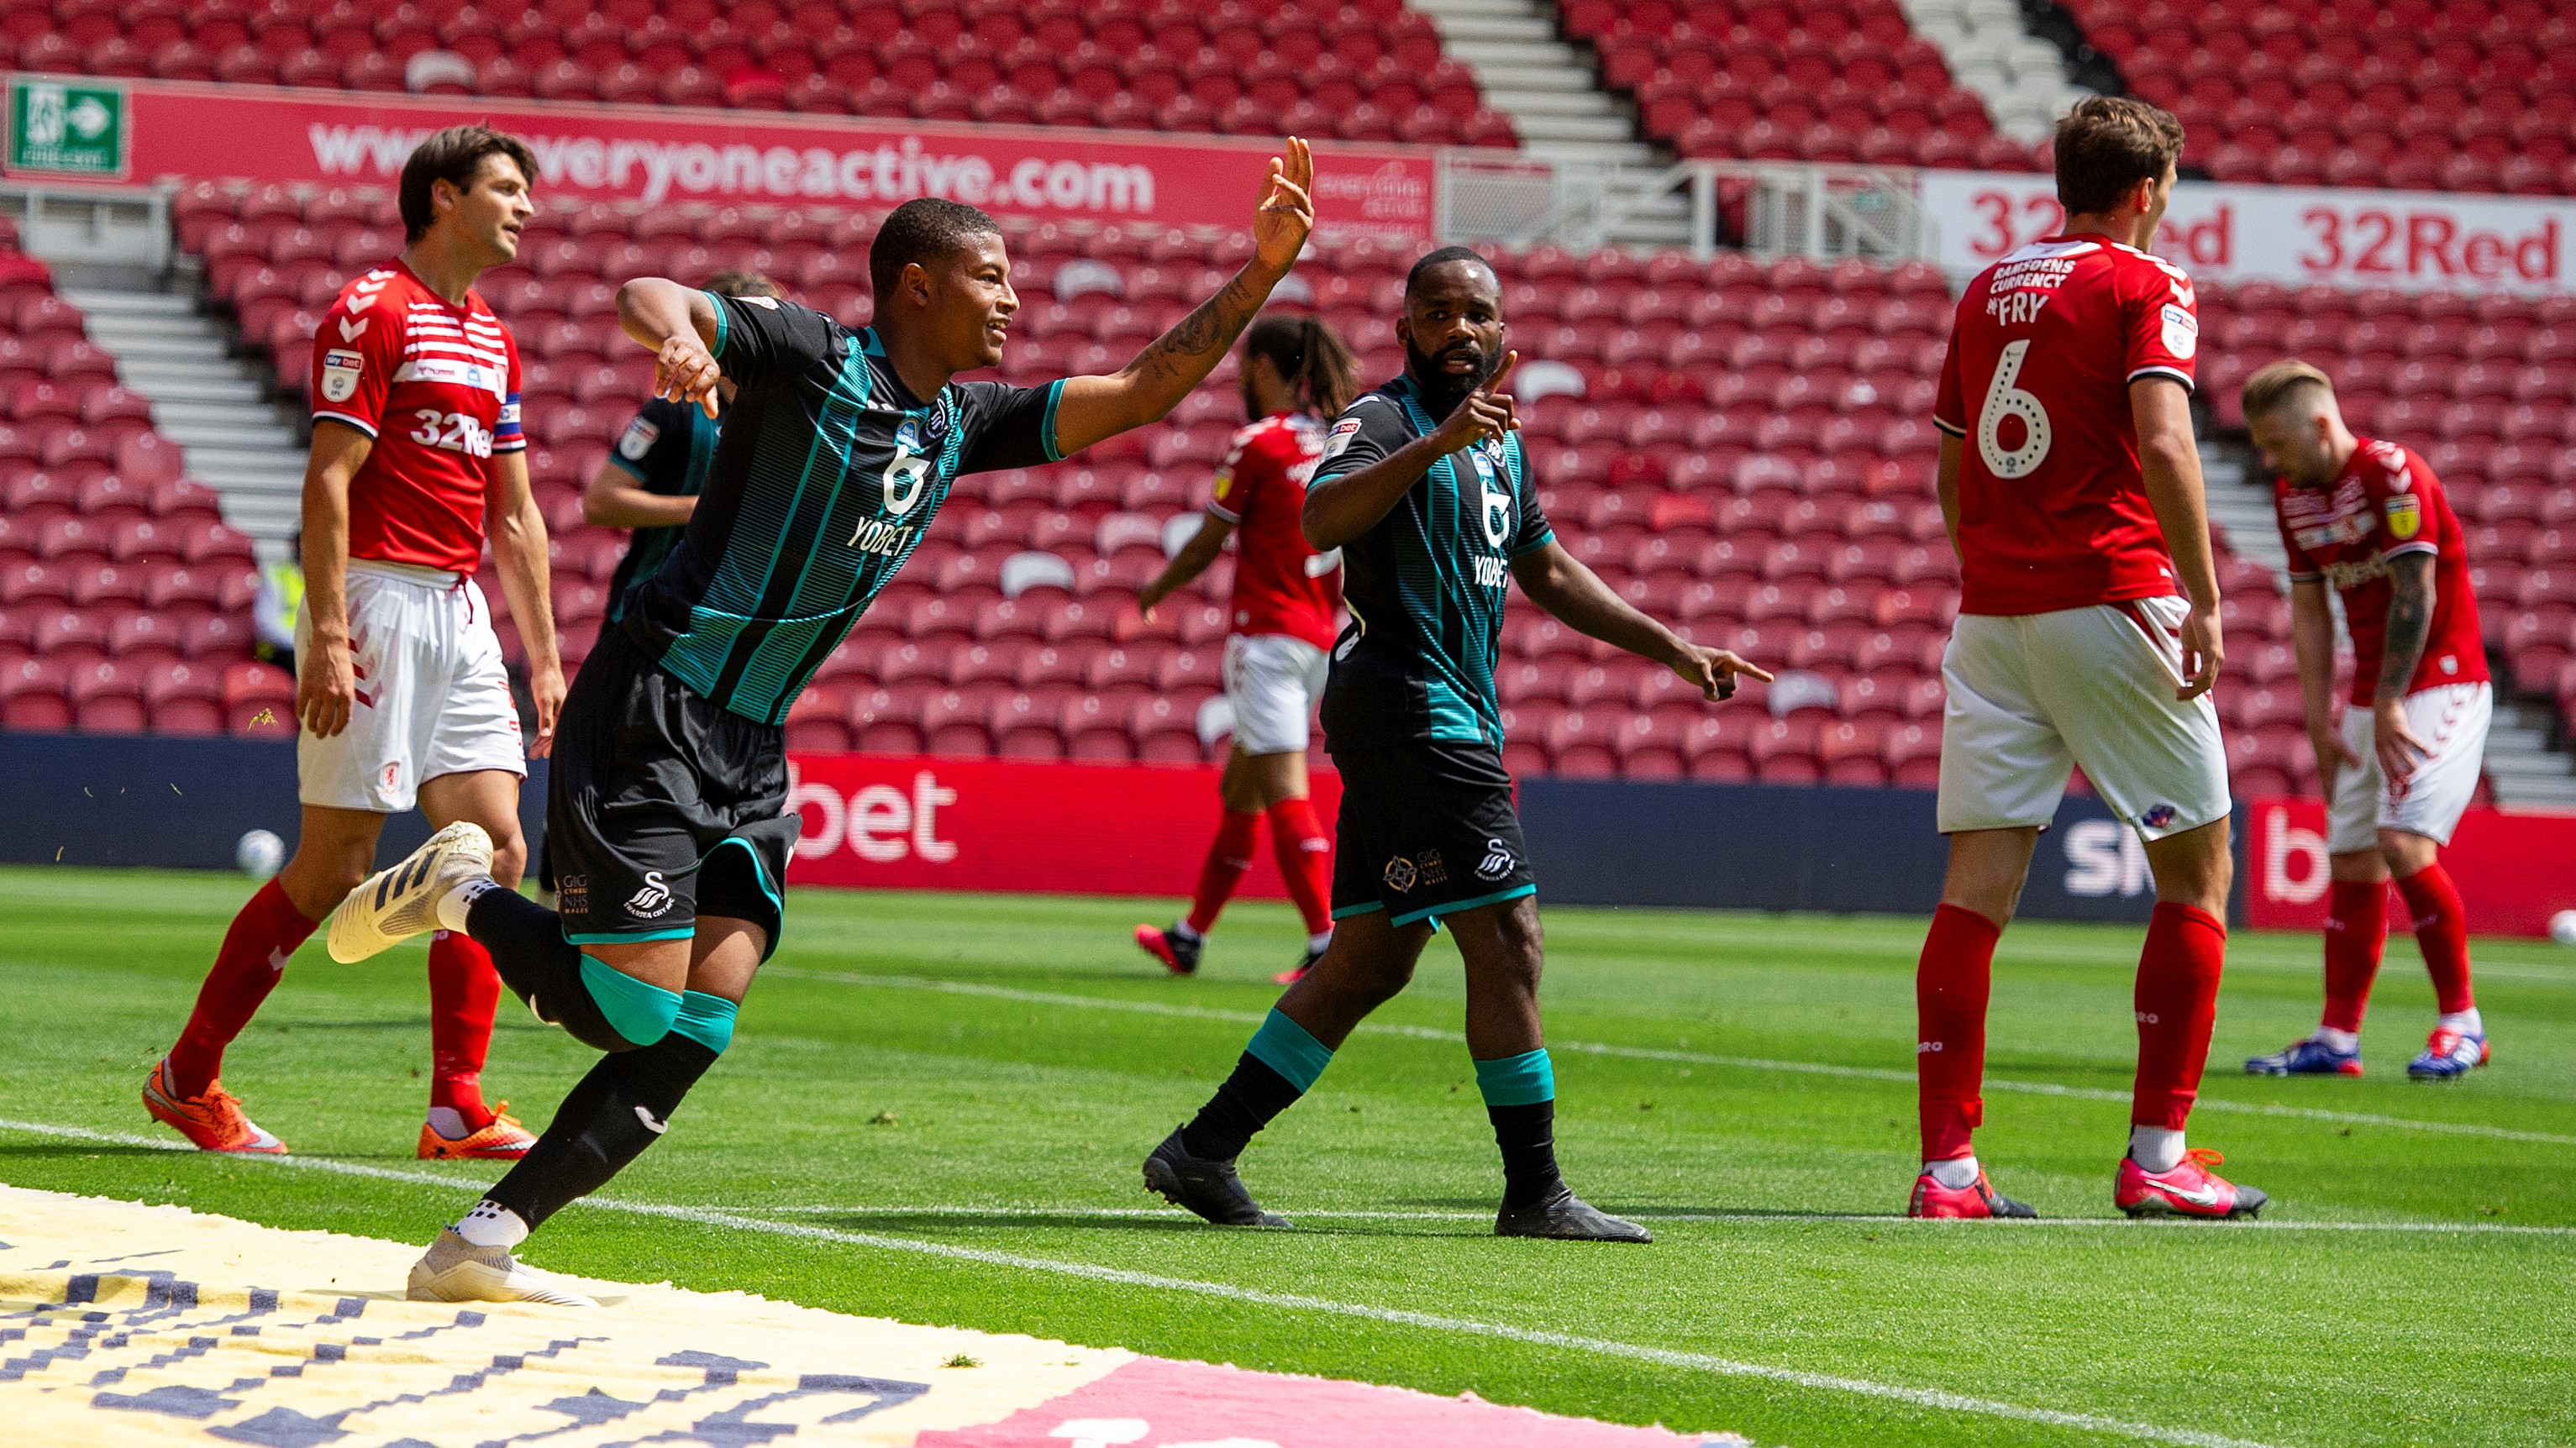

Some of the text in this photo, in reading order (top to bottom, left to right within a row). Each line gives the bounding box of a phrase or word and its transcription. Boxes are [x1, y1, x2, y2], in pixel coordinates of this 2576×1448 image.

[2303, 205, 2561, 281] 32Red
[1990, 273, 2068, 294] CURRENCY
[1993, 259, 2076, 281] RAMSDENS
[411, 408, 494, 459] 32Re
[1978, 338, 2052, 480] 6
[847, 516, 913, 556] YOBET
[786, 758, 959, 863] bet
